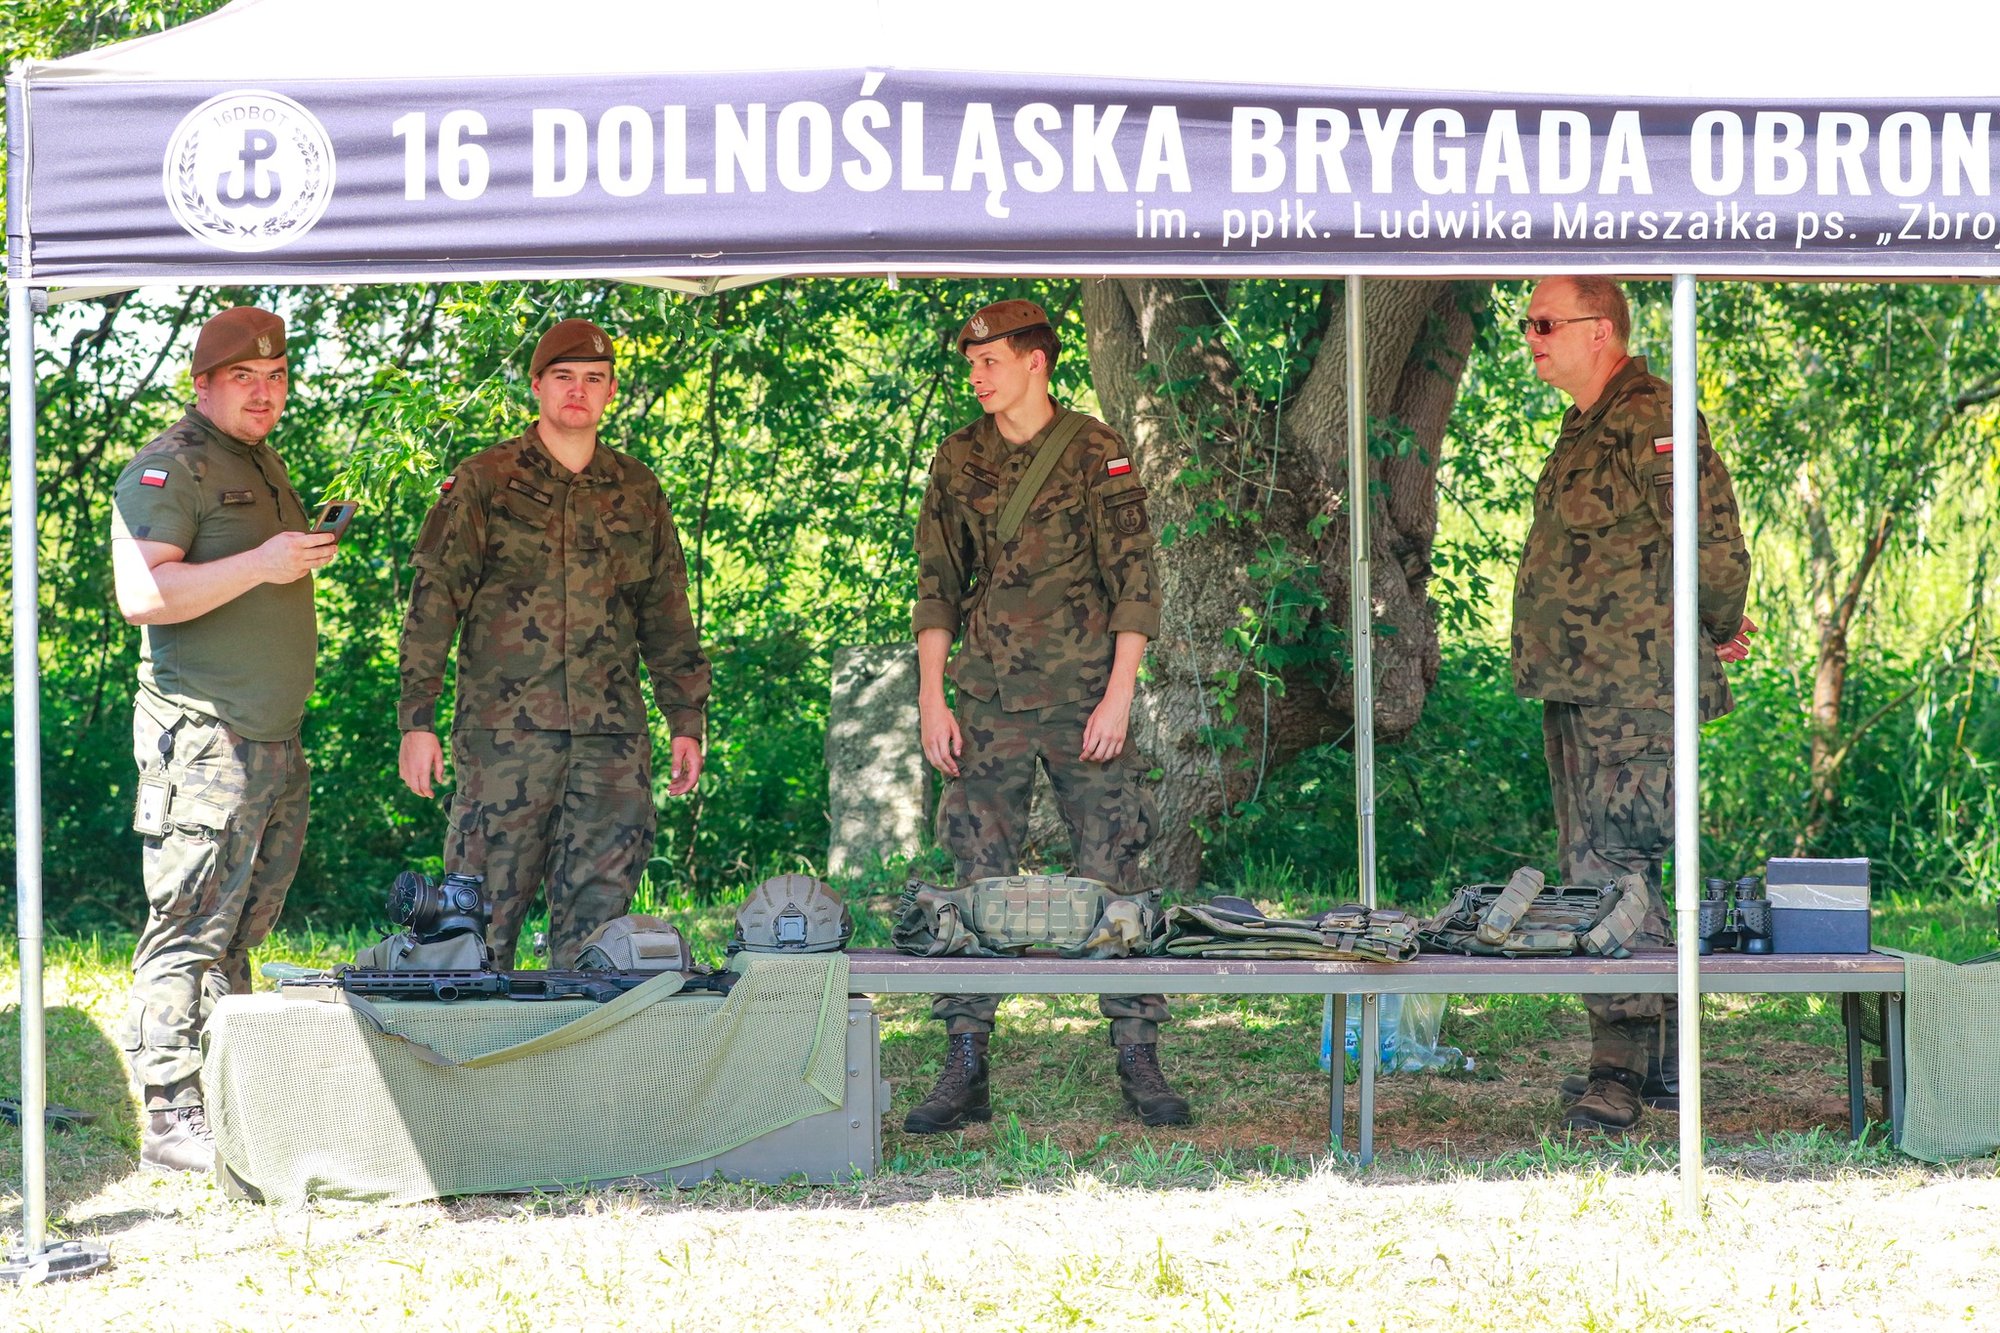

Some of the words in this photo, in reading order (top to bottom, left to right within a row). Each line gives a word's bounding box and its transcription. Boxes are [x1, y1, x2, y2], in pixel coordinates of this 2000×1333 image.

[213, 105, 289, 128] 16DBOT
[392, 109, 490, 201] 16
[532, 71, 1192, 219] DOLNOŚLĄSKA
[1231, 107, 1653, 195] BRYGADA
[1690, 110, 1991, 197] OBRON
[1136, 199, 1201, 238] im.
[1223, 198, 1331, 247] ppłk.
[1353, 199, 1532, 239] Ludwika
[1553, 201, 1776, 240] Marszałka
[1795, 211, 1857, 249] ps.
[1876, 201, 2000, 249] „Zbro
